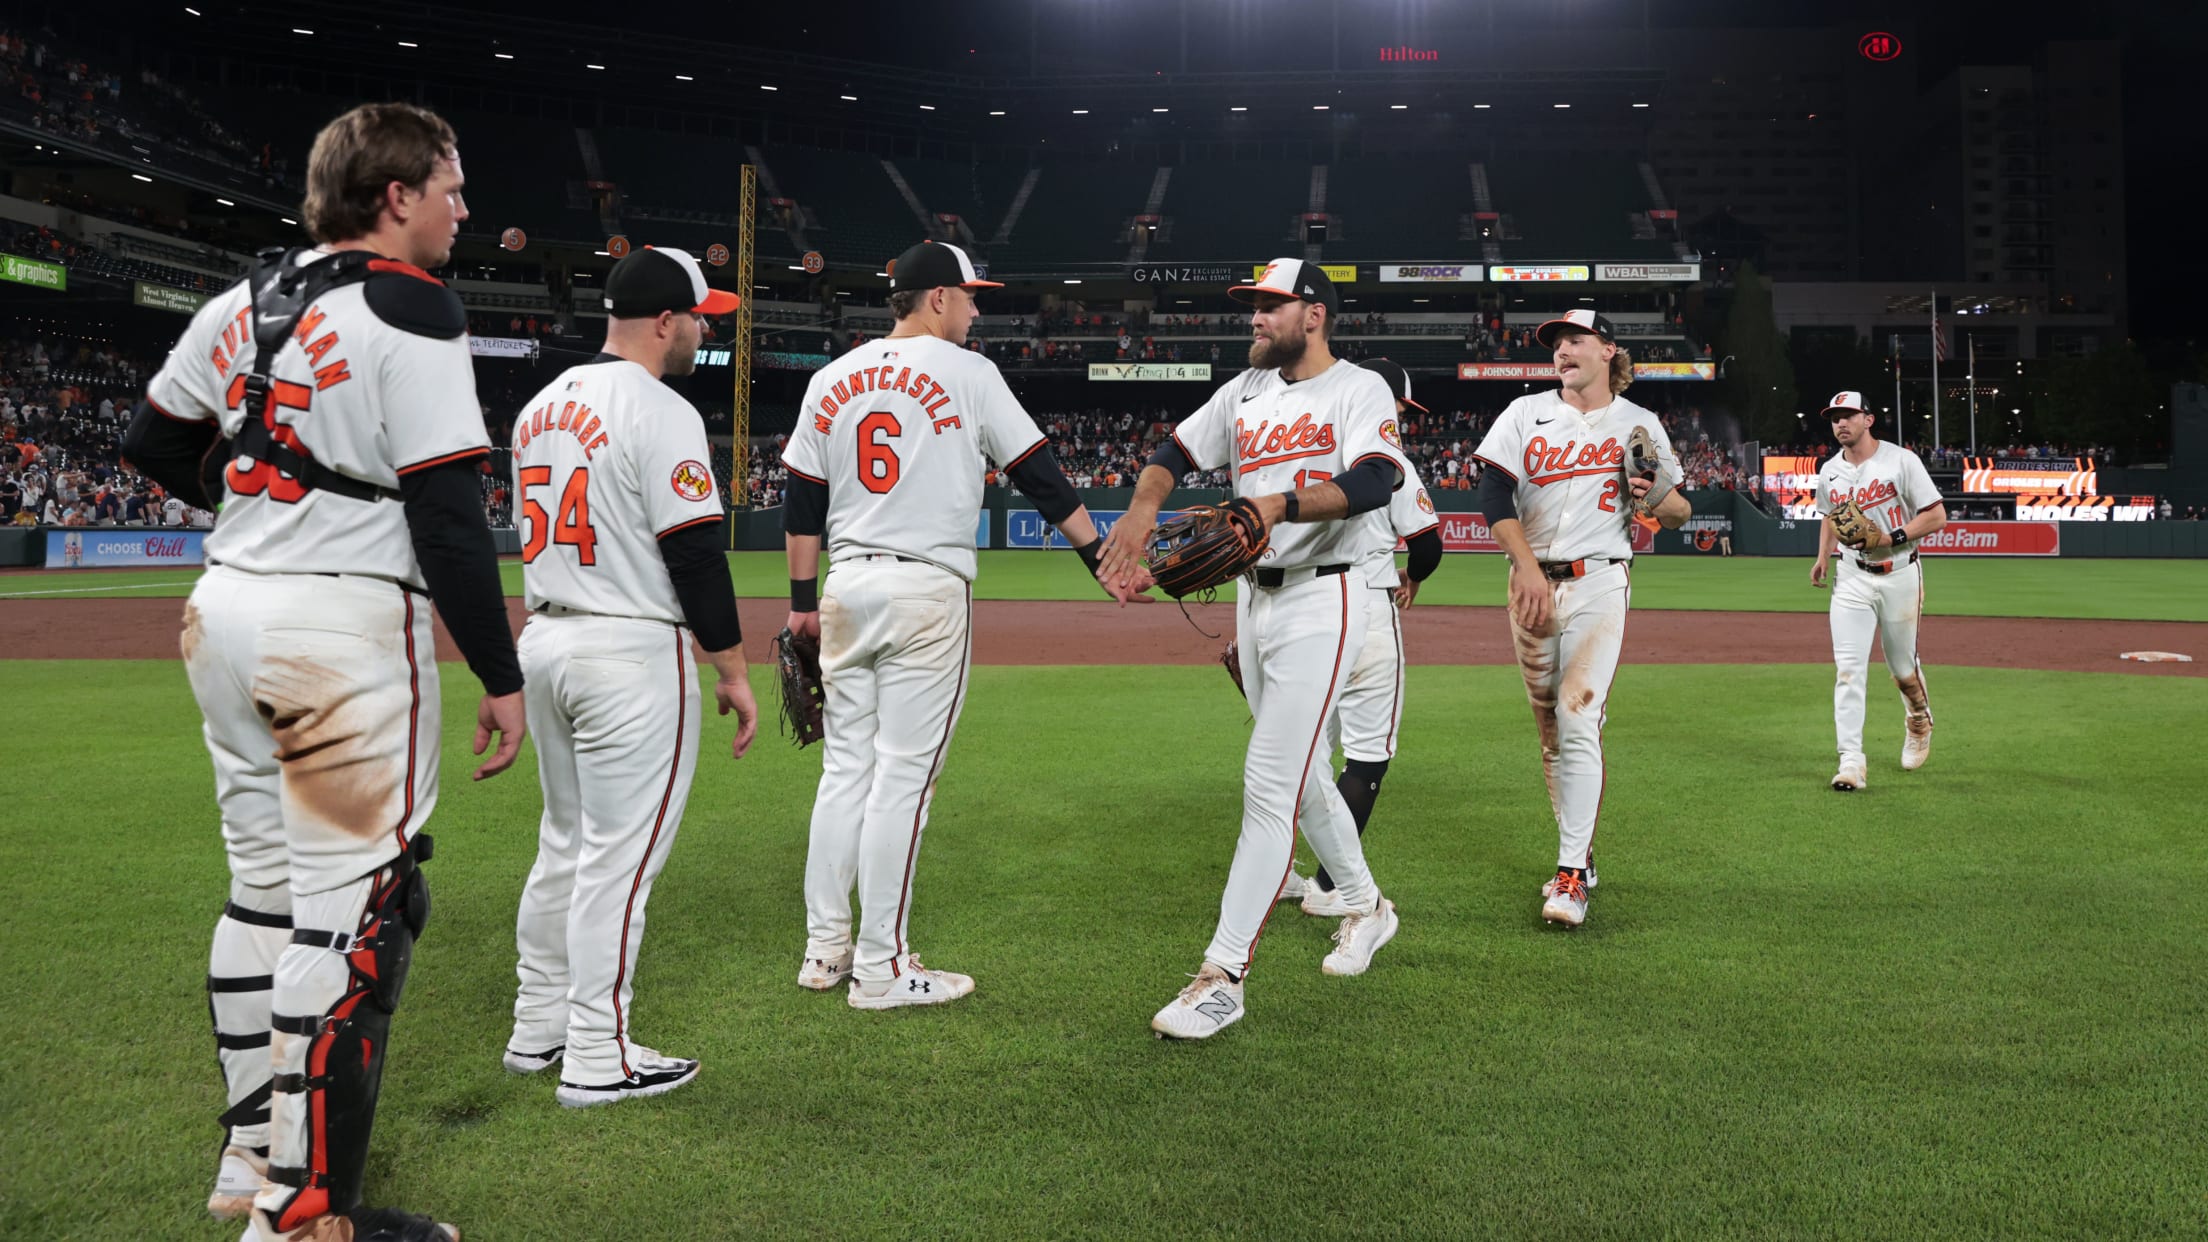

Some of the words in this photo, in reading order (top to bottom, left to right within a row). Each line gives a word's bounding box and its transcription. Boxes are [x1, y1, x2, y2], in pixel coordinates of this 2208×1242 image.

[1380, 46, 1438, 62] Hilton
[510, 230, 519, 245] 5
[613, 241, 622, 254] 4
[710, 249, 726, 261] 22
[806, 256, 821, 268] 33
[8, 258, 16, 276] &
[17, 263, 58, 285] graphics
[1134, 268, 1191, 281] GANZ
[1606, 267, 1648, 278] WBAL
[142, 286, 158, 297] West
[161, 289, 189, 303] Virginia
[142, 296, 167, 307] Almost
[1091, 367, 1109, 376] DRINK
[1192, 367, 1208, 377] LOCAL
[1482, 367, 1523, 377] JOHNSON
[815, 365, 962, 435] MOUNTCASTLE
[857, 411, 902, 494] 6
[1524, 436, 1626, 476] Oriole
[1598, 479, 1620, 513] 2
[519, 465, 597, 566] 54
[1888, 505, 1903, 529] 11
[1779, 521, 1795, 530] 376
[97, 543, 142, 555] CHOOSE
[145, 537, 187, 558] Chill
